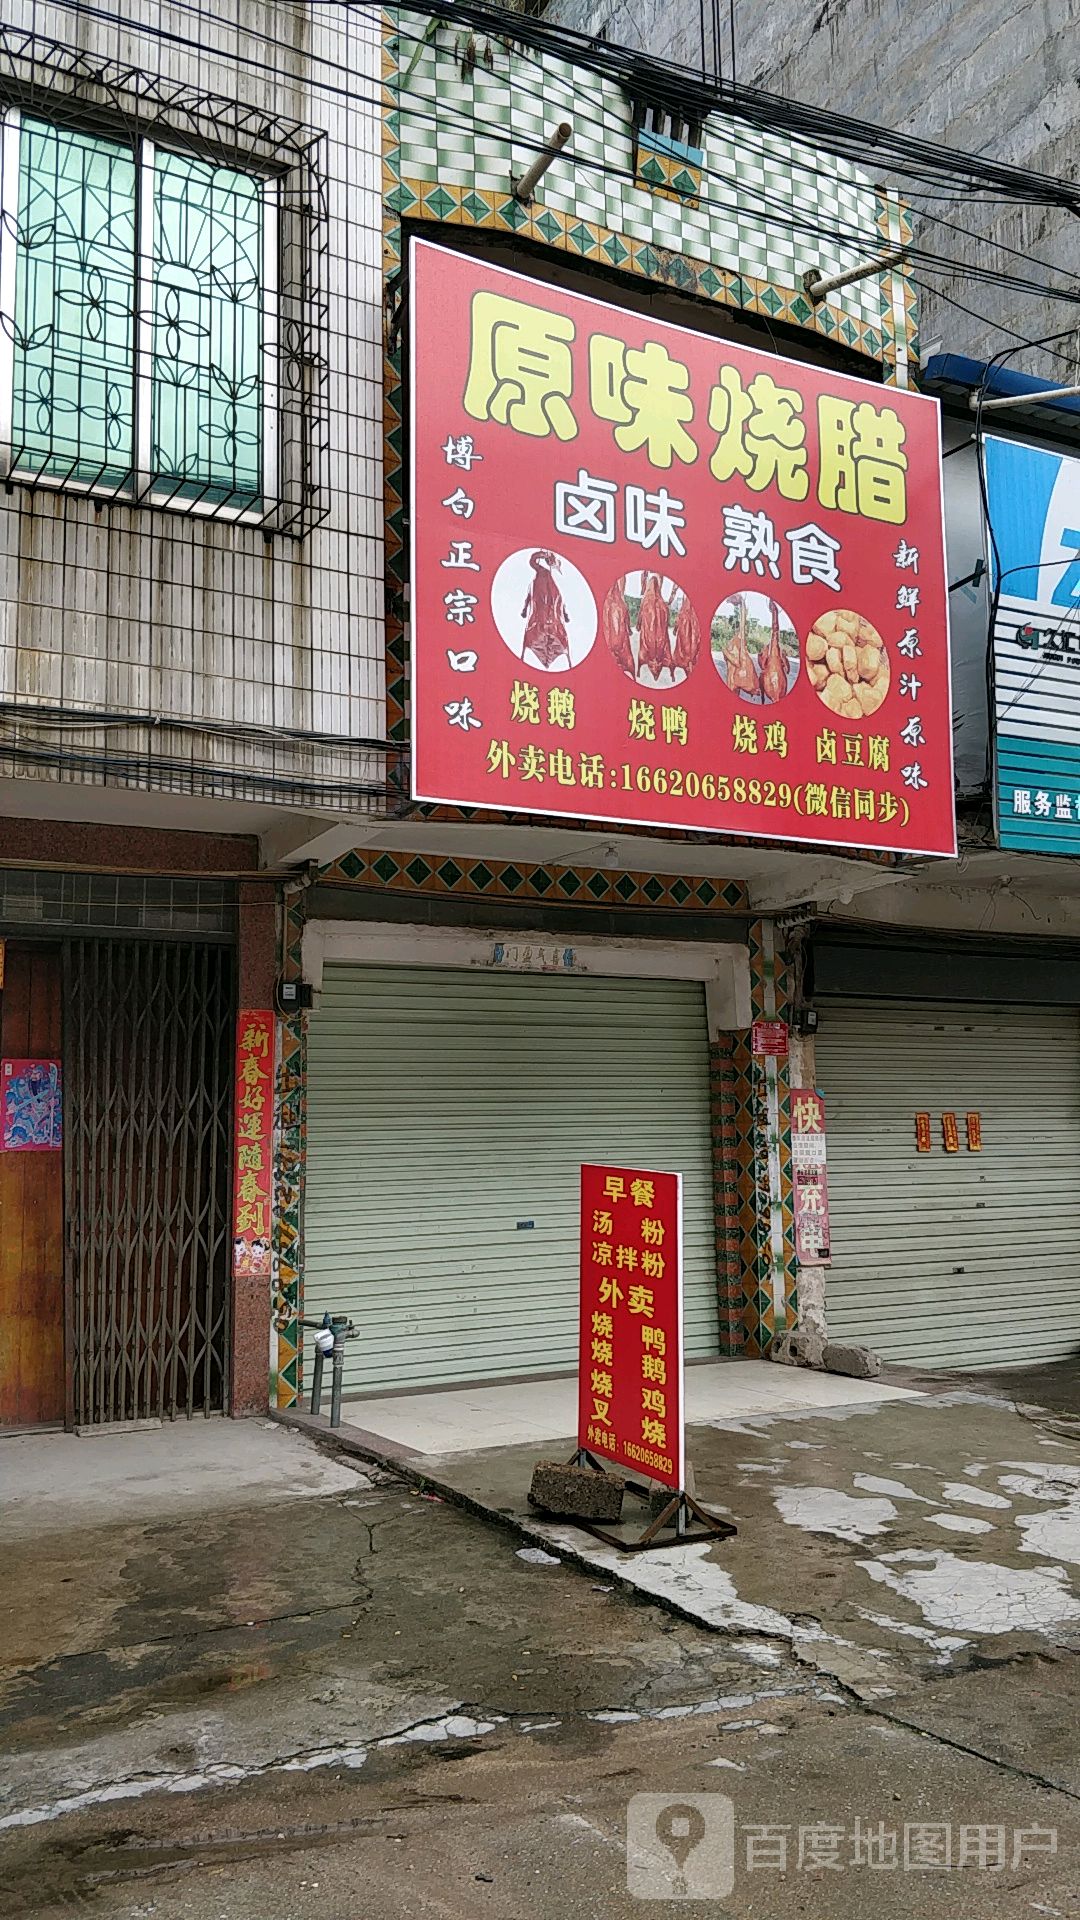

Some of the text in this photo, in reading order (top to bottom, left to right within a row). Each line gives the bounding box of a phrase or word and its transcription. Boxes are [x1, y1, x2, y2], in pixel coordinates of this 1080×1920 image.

[462, 290, 908, 525] 原味烧腊
[440, 434, 484, 732] 博白正宗口味
[553, 469, 842, 592] 卤味 熟食
[892, 538, 929, 791] 新鲜原汁原味
[510, 680, 890, 773] 烧鹅 烧鸭 烧鸡 卤豆腐
[603, 1175, 655, 1209] 早餐
[592, 1240, 666, 1279] 凉拌粉
[598, 1276, 655, 1319] 外卖
